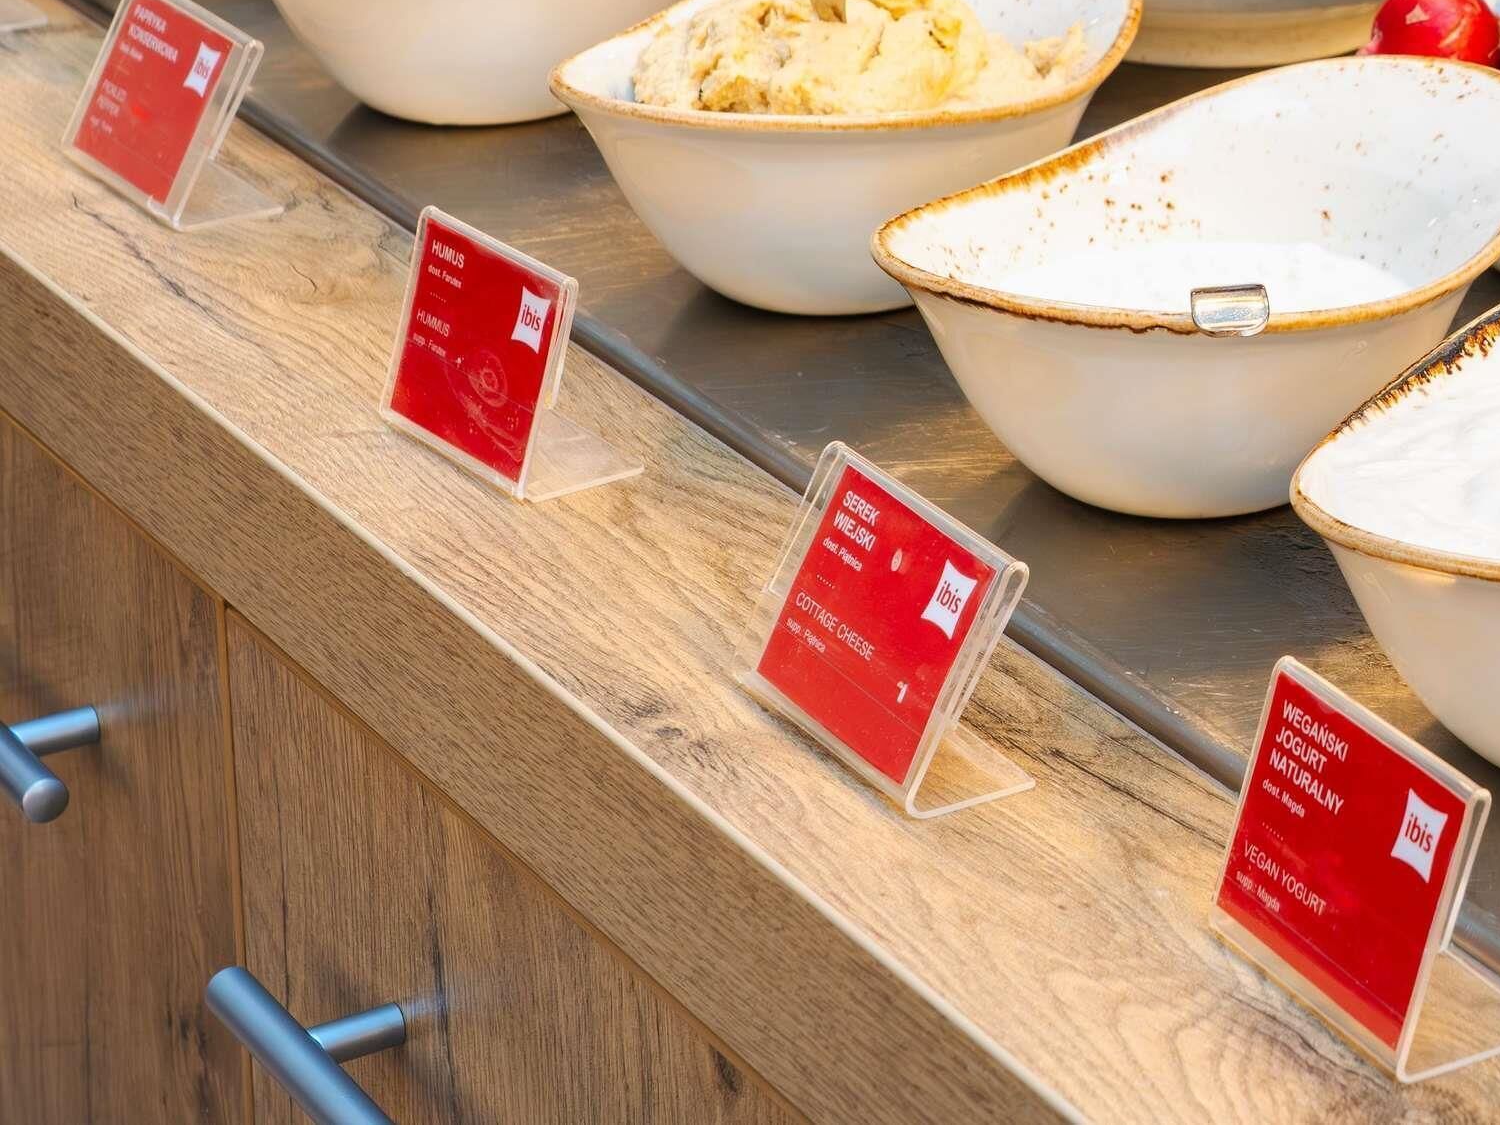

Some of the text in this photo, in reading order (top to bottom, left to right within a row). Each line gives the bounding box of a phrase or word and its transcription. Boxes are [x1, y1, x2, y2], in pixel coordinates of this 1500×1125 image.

[432, 239, 465, 269] HUMUS
[416, 307, 450, 337] HUMMUS
[521, 304, 541, 332] ibis
[843, 490, 880, 527] SEREK
[822, 536, 838, 555] dost.
[833, 510, 876, 552] WIEJSKI
[936, 580, 962, 614] ibis
[796, 592, 875, 661] COTTAGE CHEESE
[1276, 726, 1327, 773] JOGURT
[1281, 699, 1349, 762] WEGAŃSKI
[1262, 779, 1306, 818] dost. Magda
[1269, 748, 1345, 815] NATURALNY
[1404, 812, 1433, 853] ibis
[1244, 839, 1327, 916] VEGAN YOGURT
[1256, 884, 1280, 913] Magda
